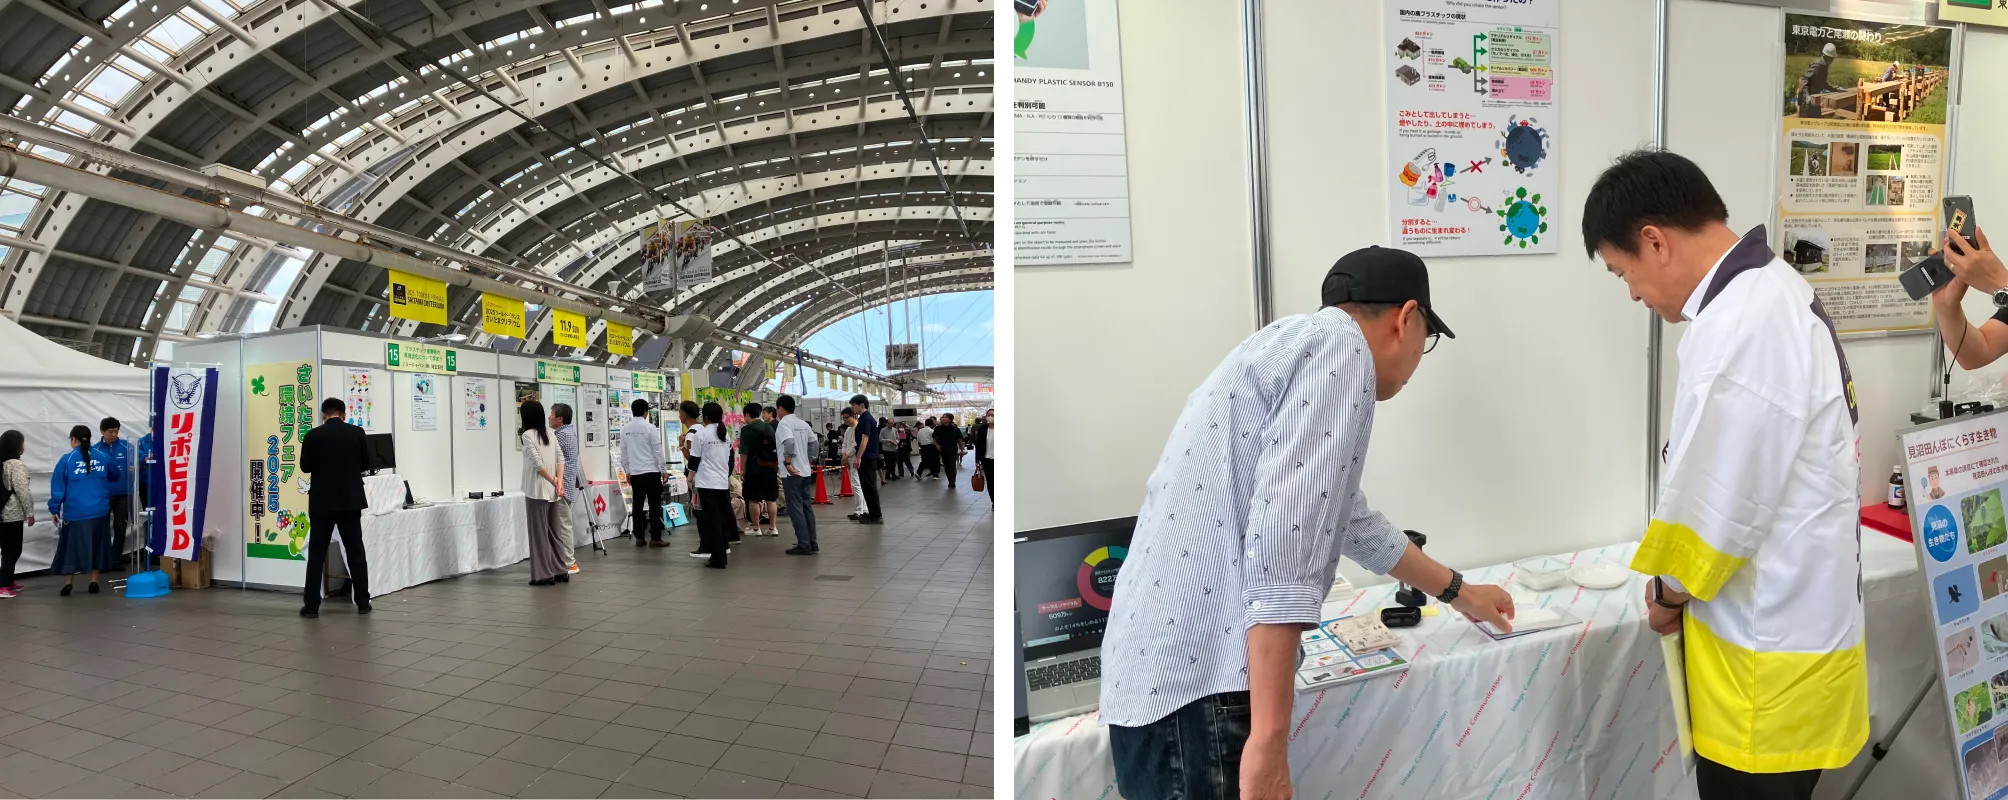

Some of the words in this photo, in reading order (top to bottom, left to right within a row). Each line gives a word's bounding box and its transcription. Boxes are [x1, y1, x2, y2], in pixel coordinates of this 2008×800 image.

[1792, 24, 1882, 42] 東京電力と尾瀬の関わり
[560, 319, 572, 332] 11.9
[389, 348, 398, 360] 15
[447, 356, 455, 367] 15
[279, 385, 295, 483] 環境フェア
[1908, 427, 1997, 459] 見沼田んぼにくらす生き物
[168, 412, 194, 550] リポビタンD
[267, 434, 279, 513] 2025
[249, 460, 265, 544] 開催中！
[1928, 531, 1956, 547] 生き物たち
[1930, 518, 1948, 531] 見沼の
[1511, 693, 1524, 713] Image
[1523, 642, 1553, 690] Communication
[1289, 689, 1326, 742] Communication
[1335, 706, 1350, 730] Image
[1456, 726, 1471, 748] Image
[1470, 675, 1503, 726] Communication
[1401, 763, 1416, 787] Image
[1415, 710, 1448, 763] Communication
[1516, 780, 1533, 800] Image
[1530, 730, 1560, 781] Communication
[1651, 754, 1665, 775] Image
